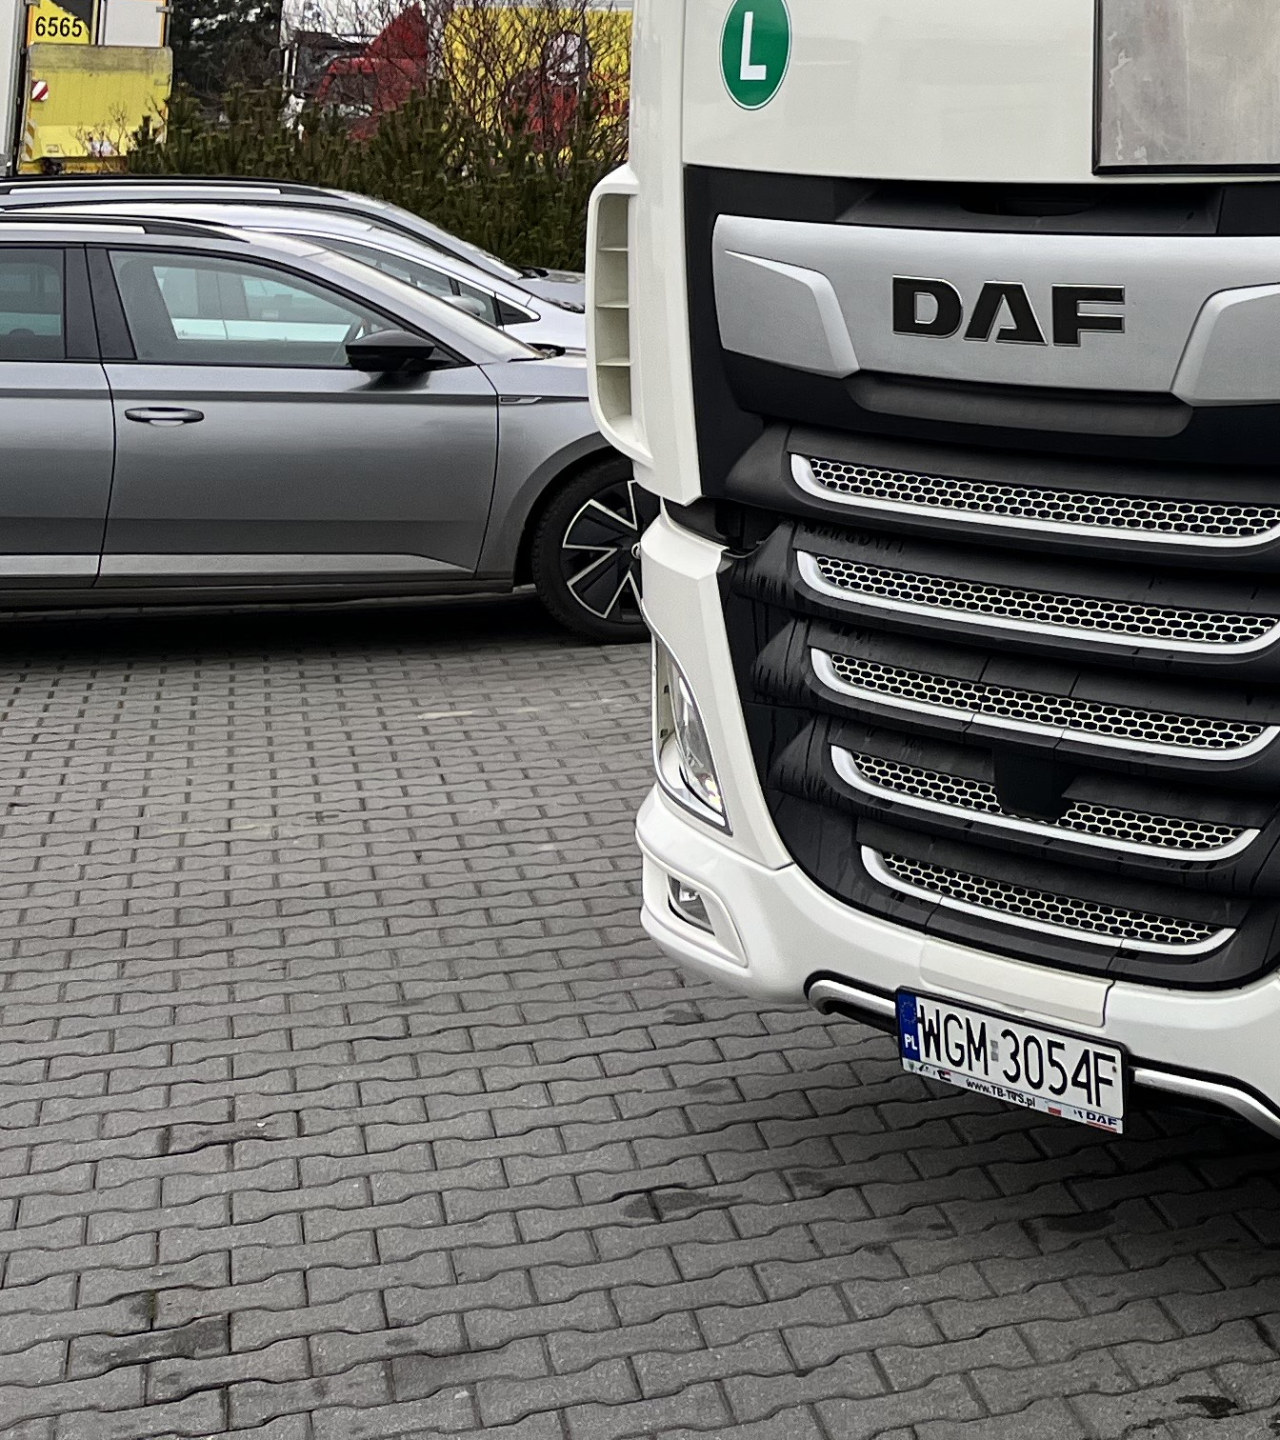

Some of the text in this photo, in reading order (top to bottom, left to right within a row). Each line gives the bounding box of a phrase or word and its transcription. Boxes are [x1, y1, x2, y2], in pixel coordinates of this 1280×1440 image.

[35, 16, 83, 38] 6565
[740, 10, 767, 80] L
[892, 273, 1126, 347] DAF
[903, 1032, 918, 1051] PL
[917, 1004, 1117, 1108] WGM 3054F
[1086, 1111, 1118, 1126] DAF
